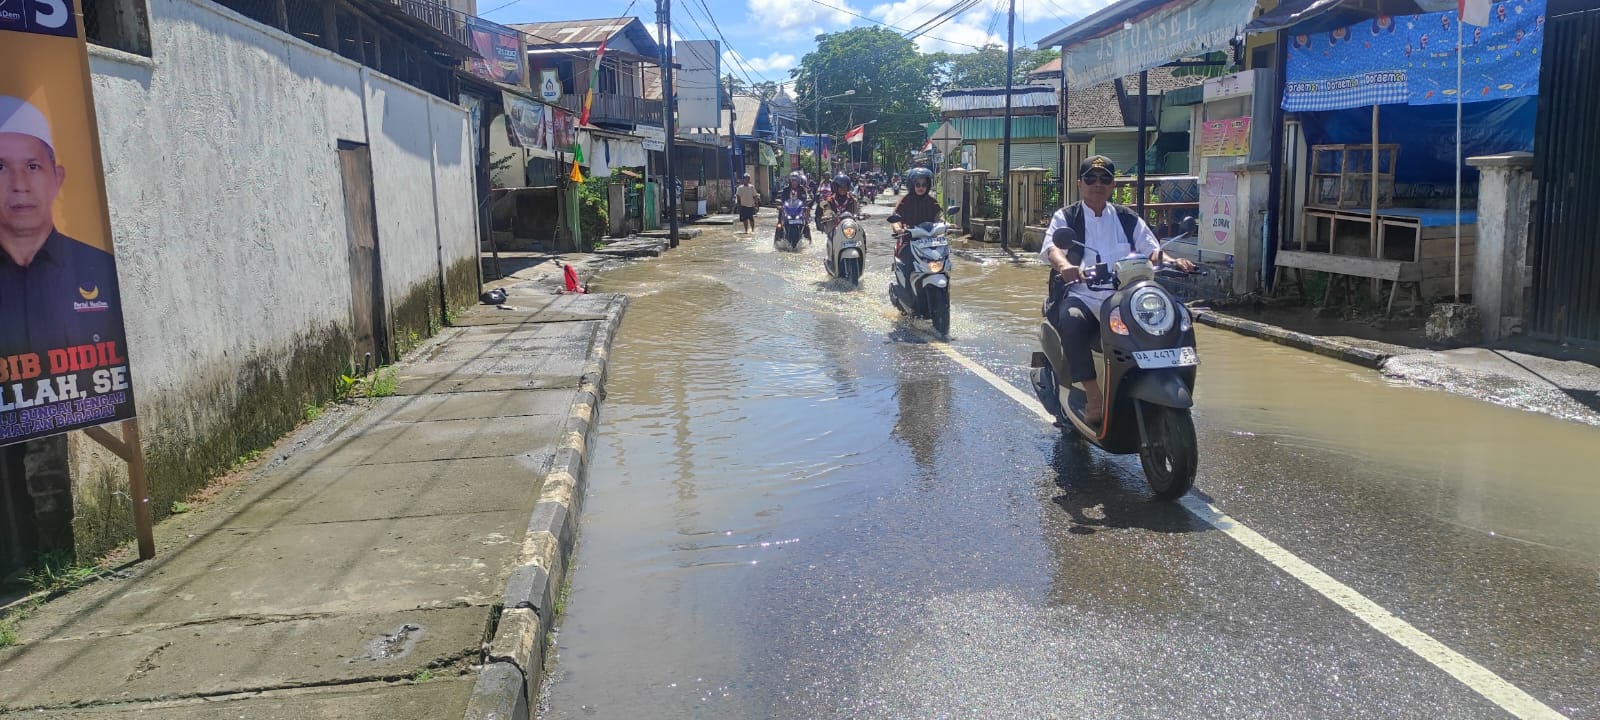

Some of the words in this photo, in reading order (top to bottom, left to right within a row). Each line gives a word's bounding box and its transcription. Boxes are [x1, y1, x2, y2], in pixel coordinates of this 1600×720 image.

[0, 10, 20, 20] Dem
[1119, 9, 1197, 49] PONSEL
[1365, 72, 1406, 84] Doraemon
[48, 341, 125, 374] DIDIL
[1154, 349, 1176, 359] 4477
[92, 366, 128, 393] SE
[20, 402, 73, 422] SUNGAI
[75, 391, 126, 413] TENGAH
[56, 405, 117, 427] BARABAI
